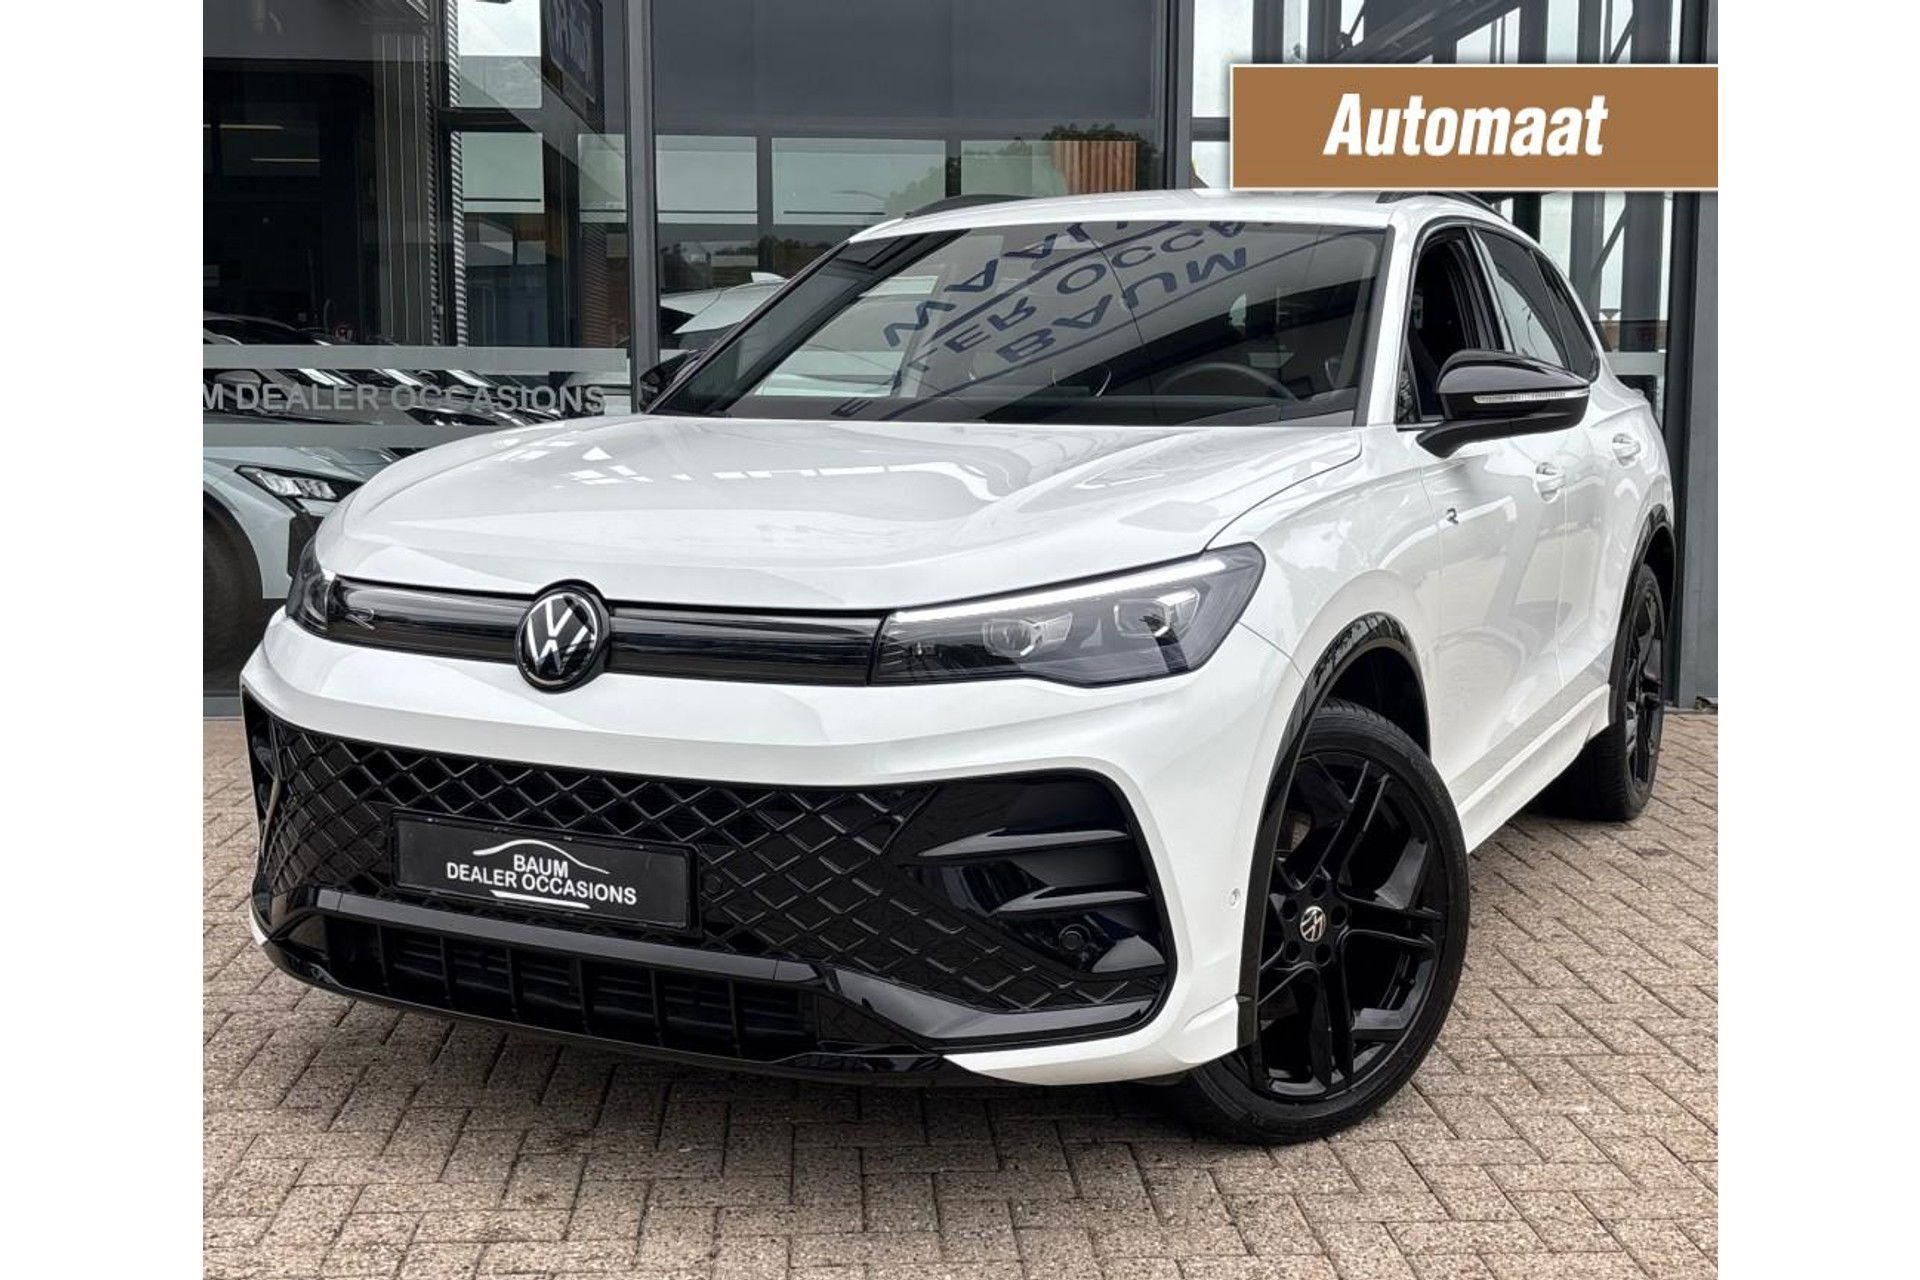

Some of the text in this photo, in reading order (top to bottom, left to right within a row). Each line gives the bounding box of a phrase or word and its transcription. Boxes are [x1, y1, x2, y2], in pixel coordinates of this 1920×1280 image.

[237, 383, 379, 411] DEALER
[391, 384, 605, 412] OCCASIONS
[513, 854, 569, 878] BAUM
[447, 861, 638, 905] DEALER OCCASIONS
